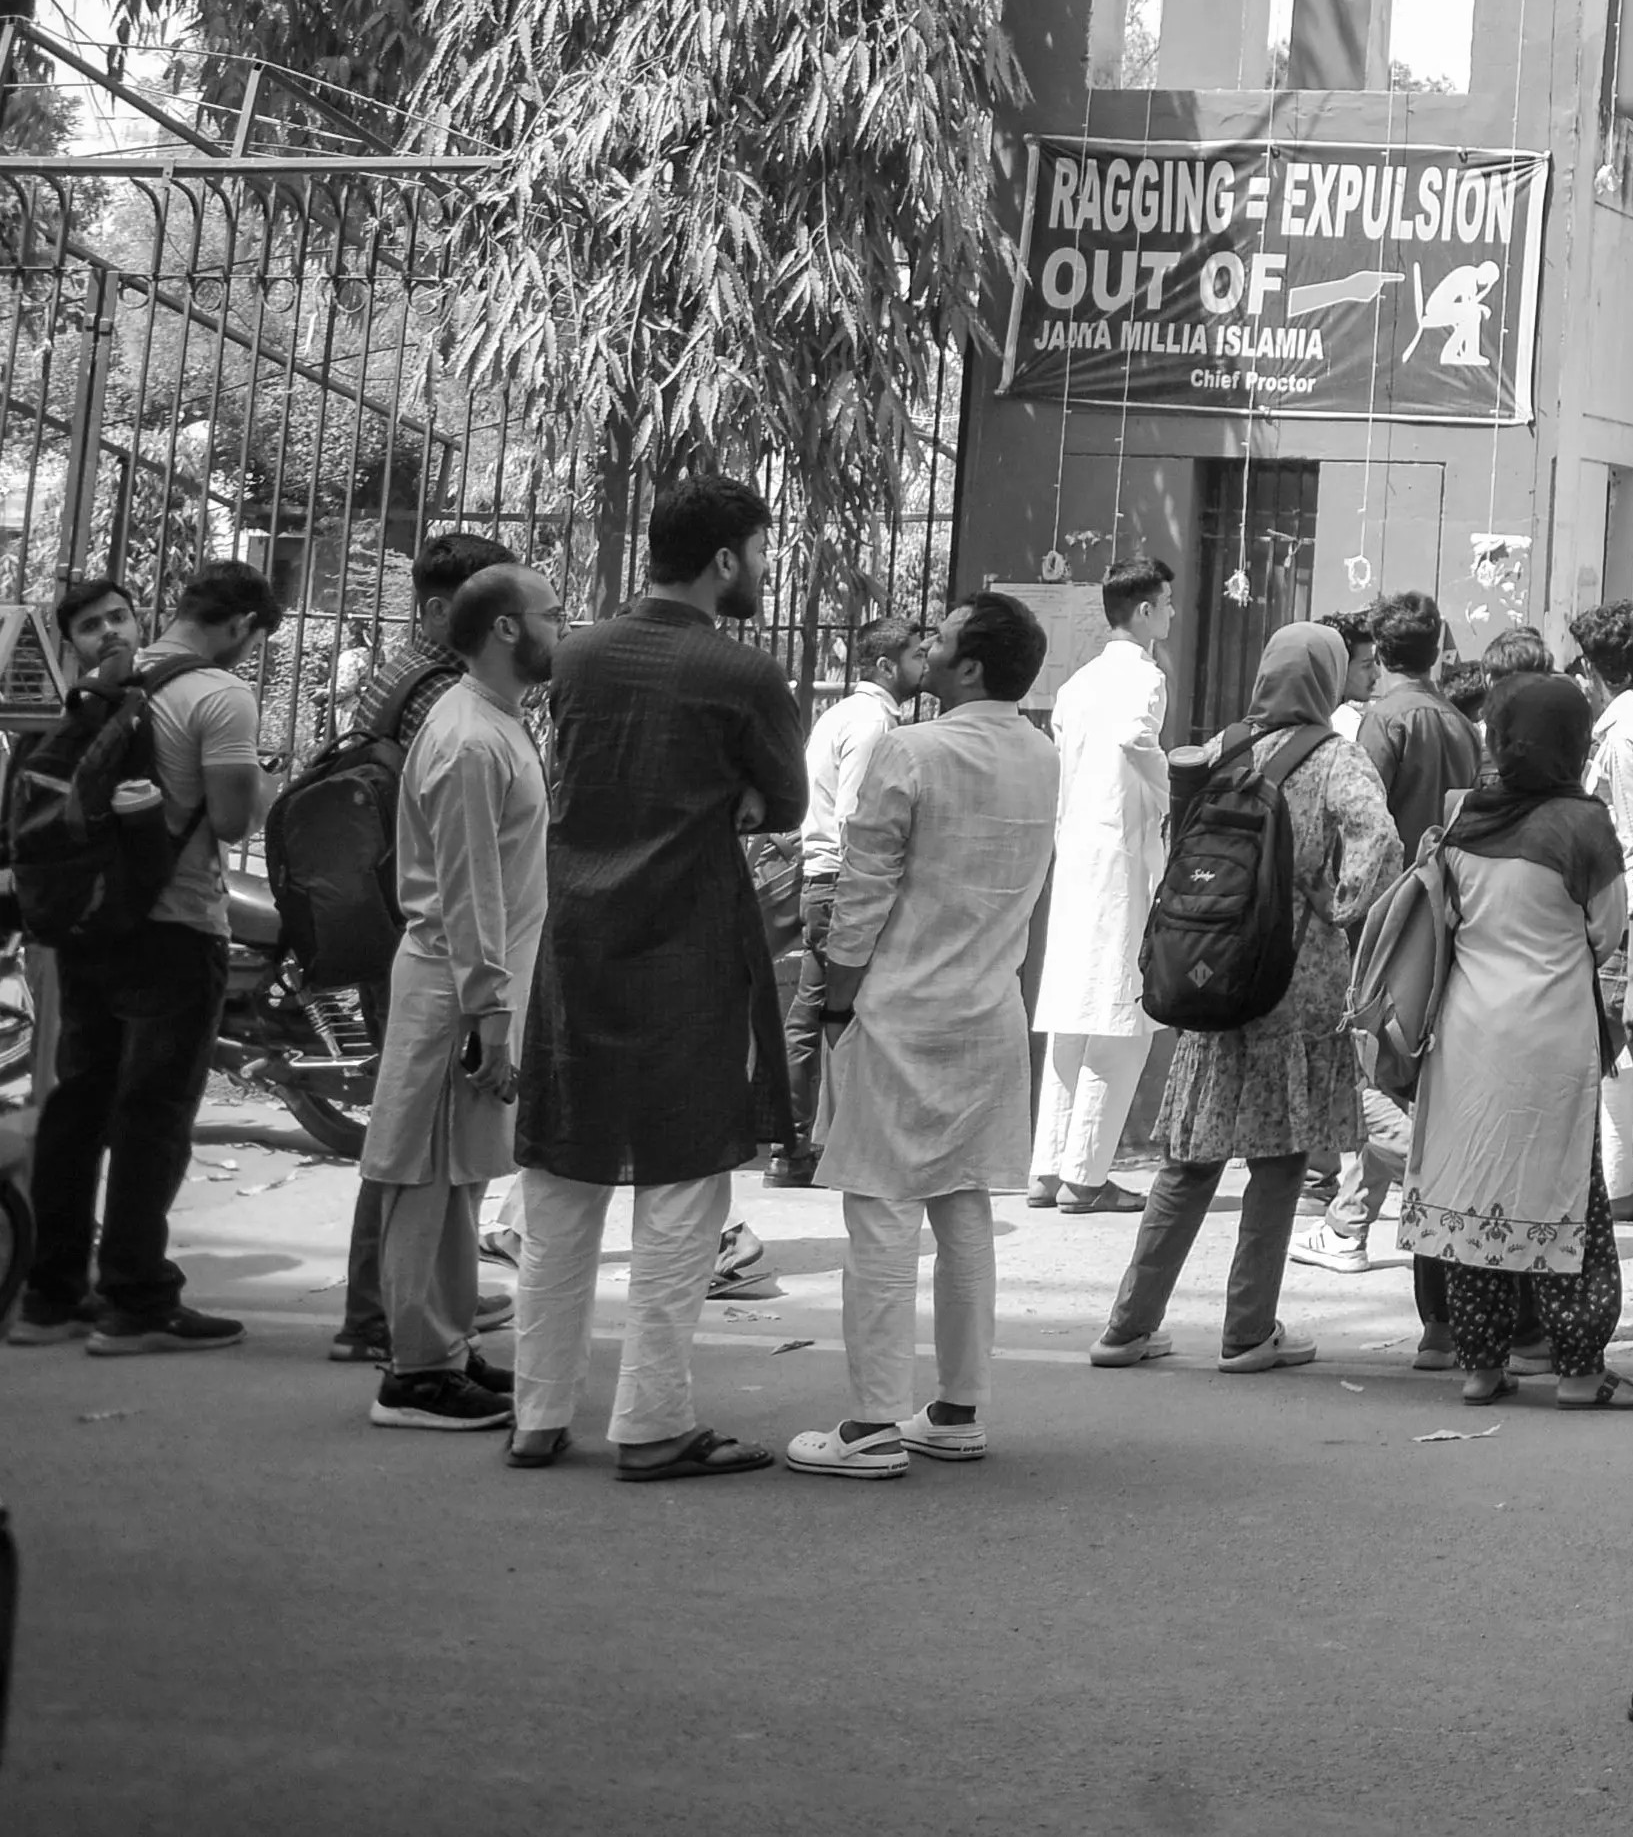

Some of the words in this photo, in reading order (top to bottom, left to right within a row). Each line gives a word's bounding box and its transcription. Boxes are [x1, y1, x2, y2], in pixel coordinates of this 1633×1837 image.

[1049, 158, 1235, 234] RAGGING
[1280, 163, 1516, 244] EXPULSION
[1041, 247, 1181, 311] OUT
[1200, 251, 1287, 315] OF
[1034, 320, 1112, 352] JAMIA
[1120, 321, 1208, 355] MILLIA
[1216, 326, 1324, 361] ISLAMIA
[1190, 368, 1240, 391] Chief
[1245, 370, 1317, 394] Proctor
